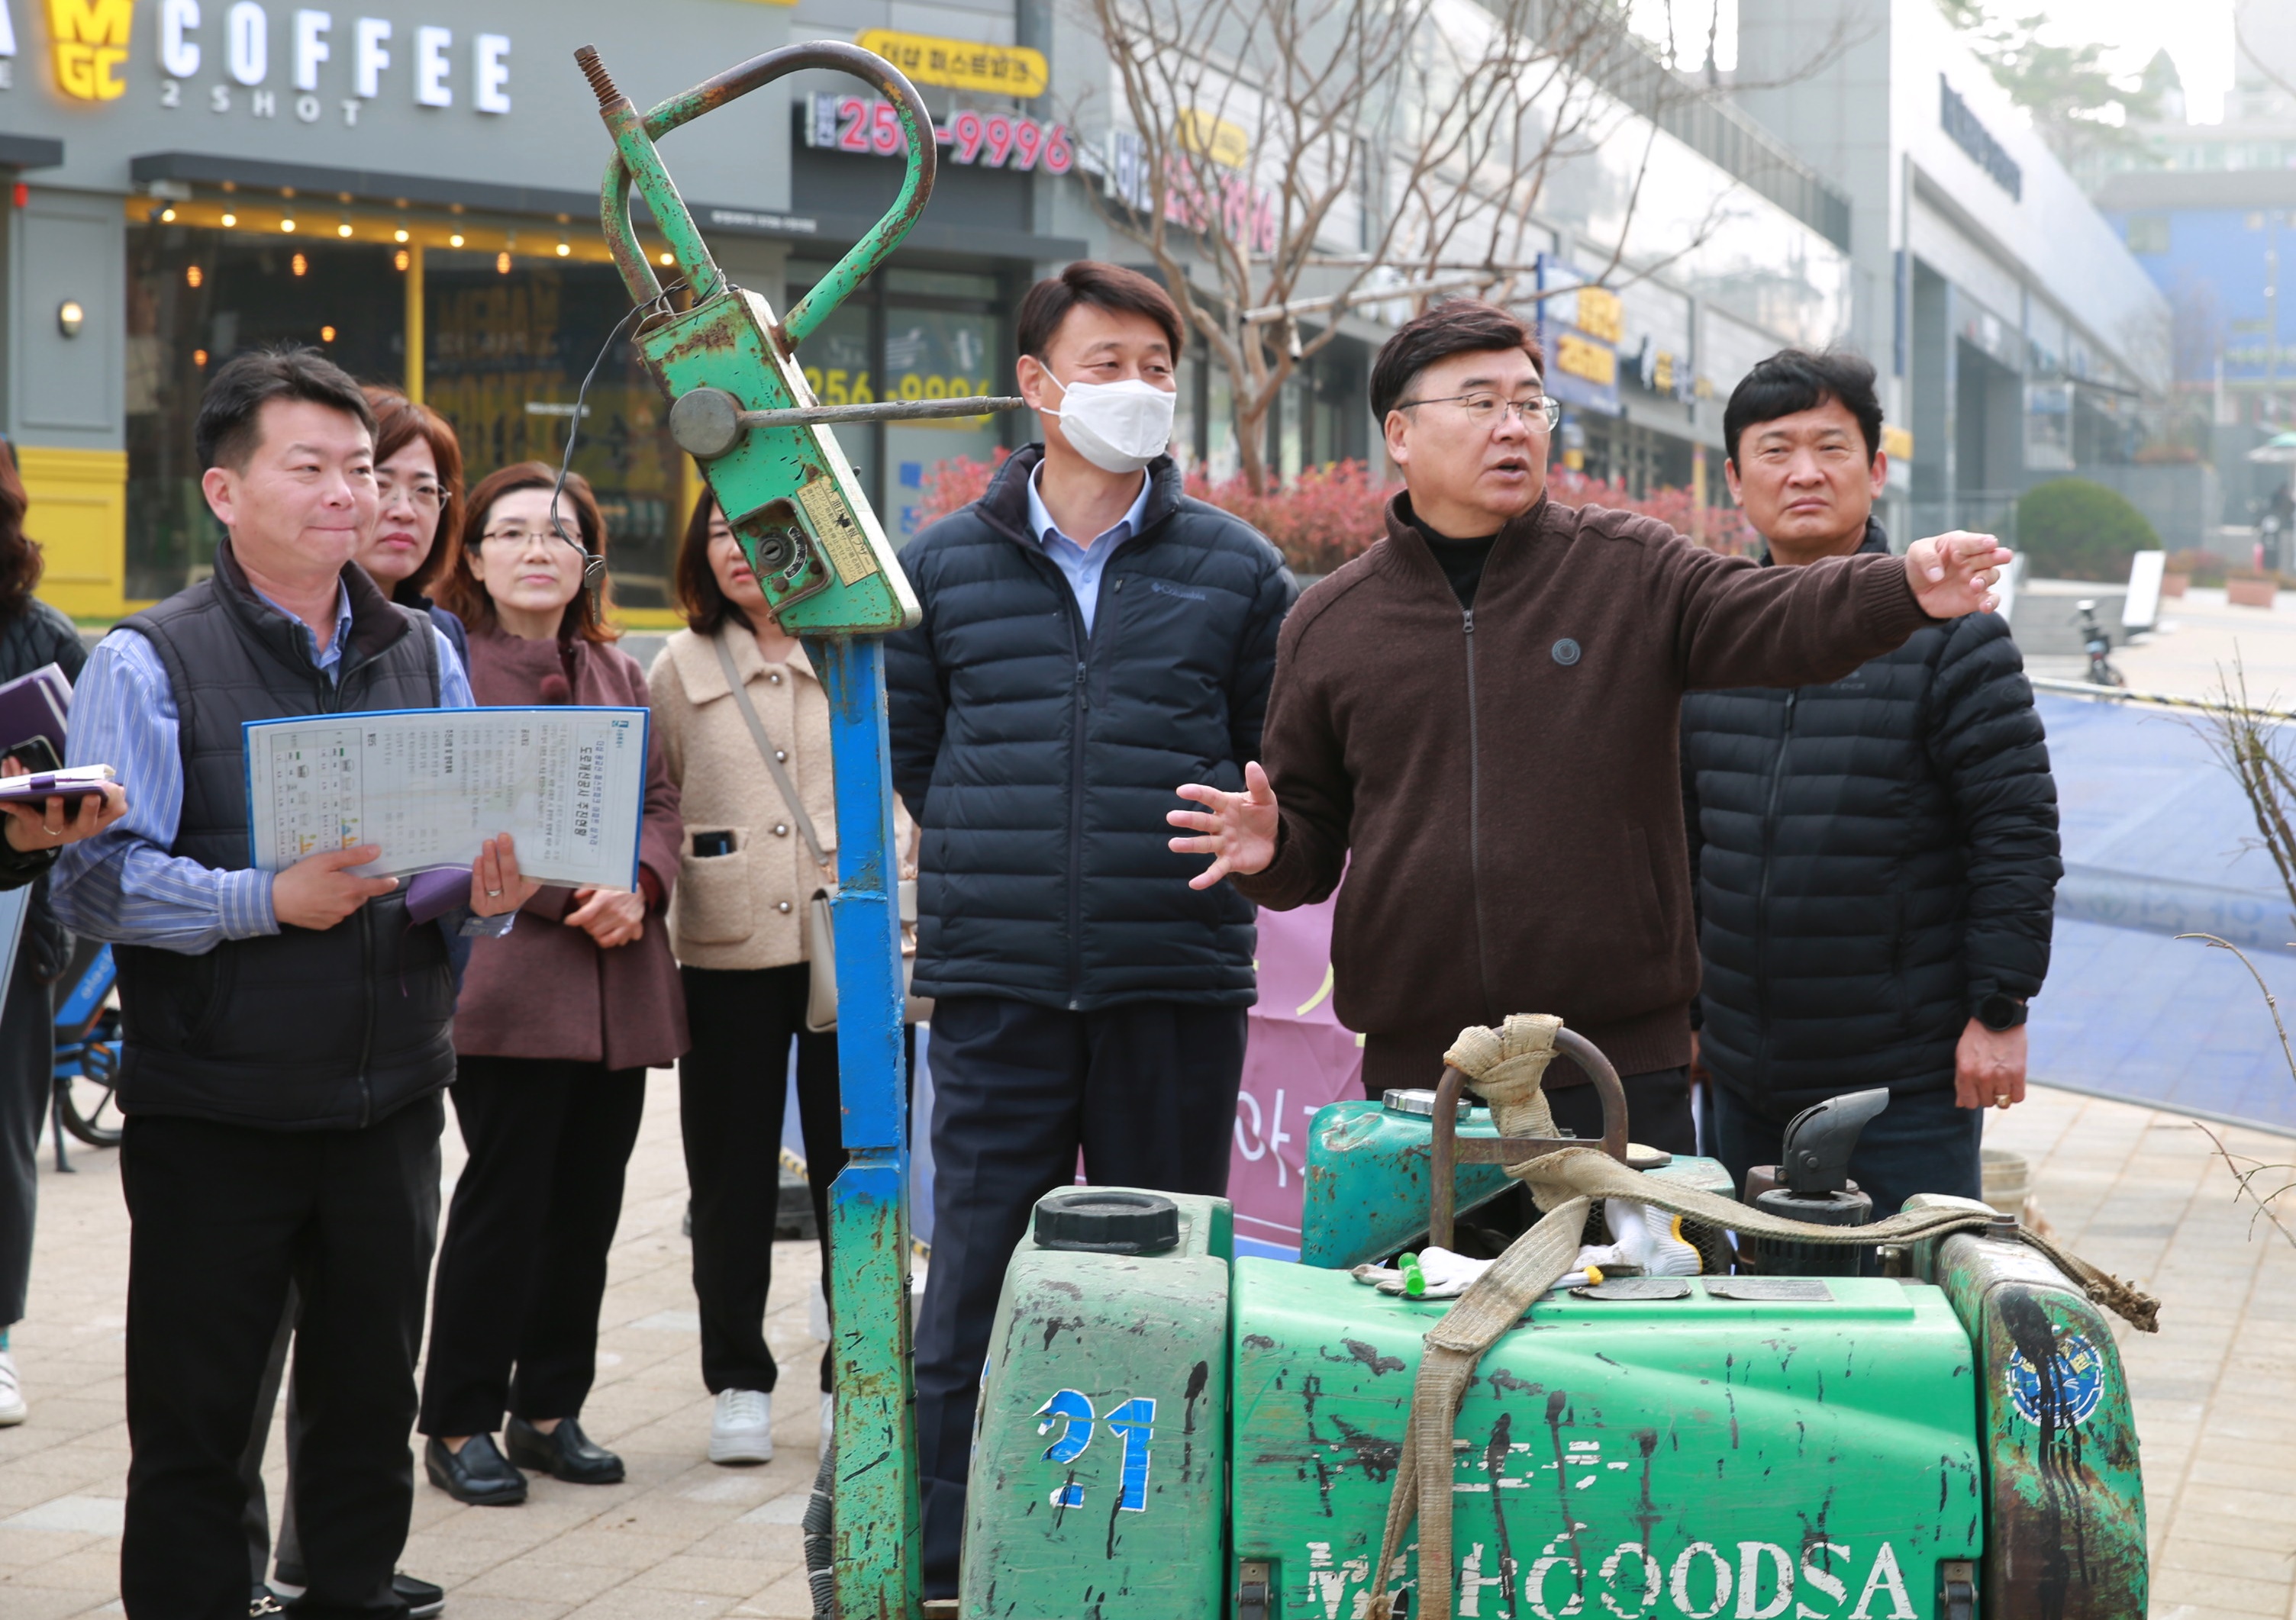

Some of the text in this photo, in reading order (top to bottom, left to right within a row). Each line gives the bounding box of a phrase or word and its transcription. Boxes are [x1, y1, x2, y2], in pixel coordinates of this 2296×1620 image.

[159, 0, 511, 114] COFFEE
[161, 80, 362, 127] 2 SHOT
[840, 97, 1073, 176] 25-9996
[574, 747, 592, 836] 도로개선공사 추진현황
[1030, 1388, 1156, 1512] 21
